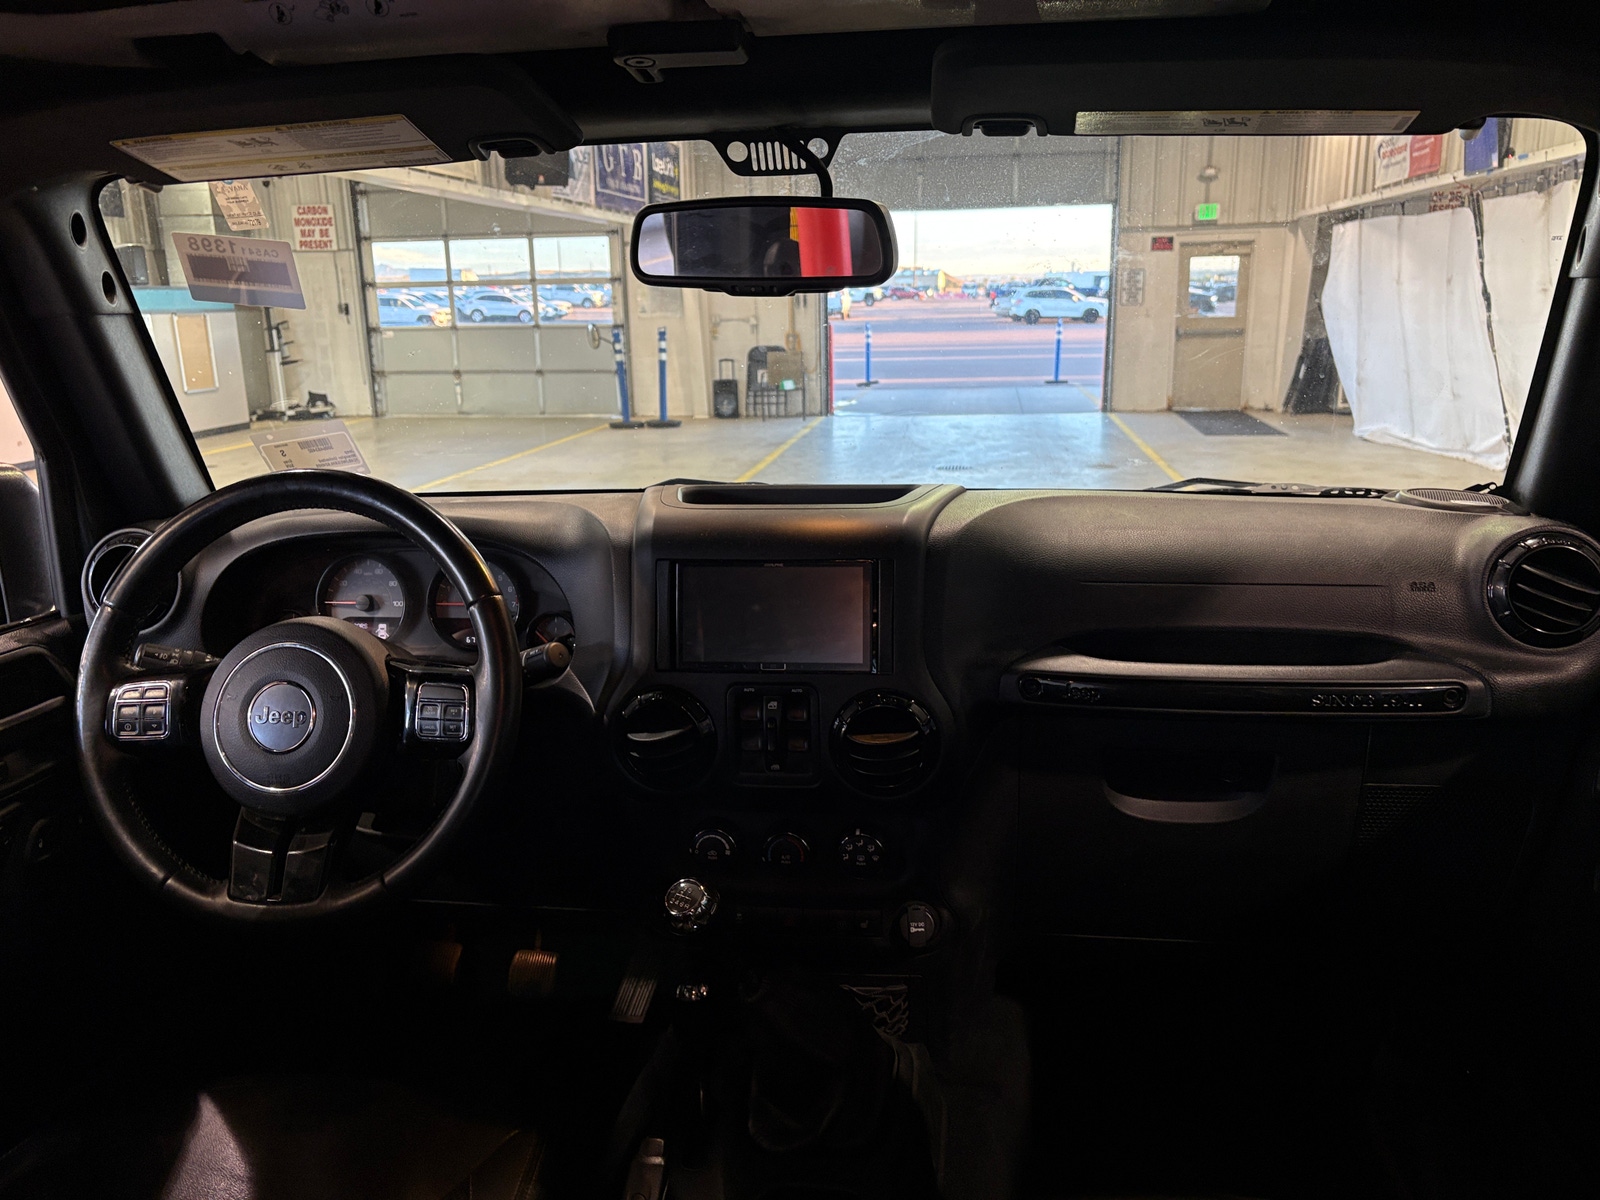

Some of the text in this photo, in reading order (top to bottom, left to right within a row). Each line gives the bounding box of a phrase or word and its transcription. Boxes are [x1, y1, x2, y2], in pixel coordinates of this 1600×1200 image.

[297, 206, 328, 215] CARBON
[1200, 205, 1217, 218] EXIT
[294, 217, 333, 226] MONOXIDE
[300, 228, 330, 238] MAY BE
[299, 240, 333, 249] PRESENT
[255, 706, 307, 728] Jeep
